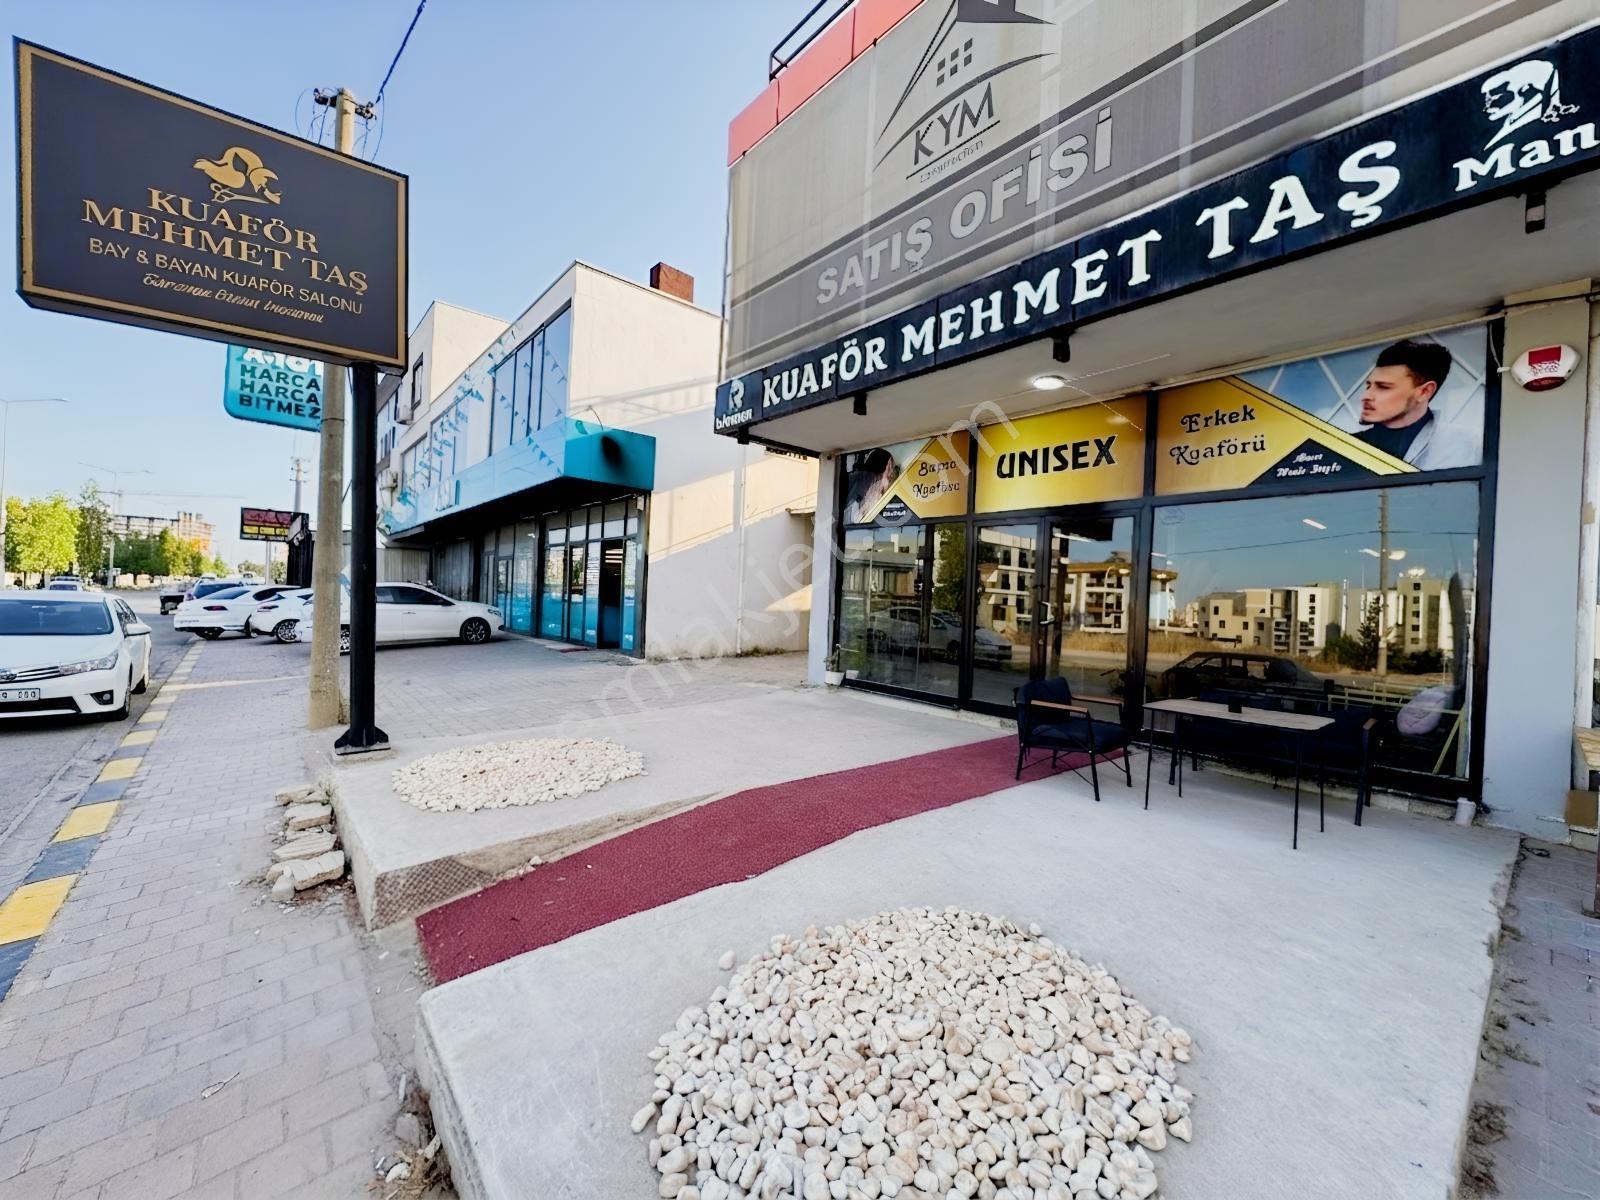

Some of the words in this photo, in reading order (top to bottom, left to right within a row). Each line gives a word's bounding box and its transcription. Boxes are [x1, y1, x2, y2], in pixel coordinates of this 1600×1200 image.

[913, 81, 994, 166] KYM
[1452, 122, 1600, 192] Man
[146, 187, 319, 254] KUAFÖR
[816, 216, 934, 305] SATIŞ
[949, 105, 1113, 240] OFİSİ
[81, 199, 292, 272] MEHMET
[301, 257, 369, 296] TAŞ
[89, 237, 130, 260] BAY
[135, 249, 150, 265] &
[155, 253, 218, 281] BAYAN
[222, 270, 295, 299] KUAFÖR
[299, 288, 363, 315] SALONU
[762, 338, 888, 409] KUAFÖR
[900, 229, 1163, 363] MEHMET
[1195, 139, 1401, 260] TAŞ
[239, 378, 321, 407] HARCA
[1179, 404, 1256, 434] Erkek
[996, 434, 1118, 480] UNISEX
